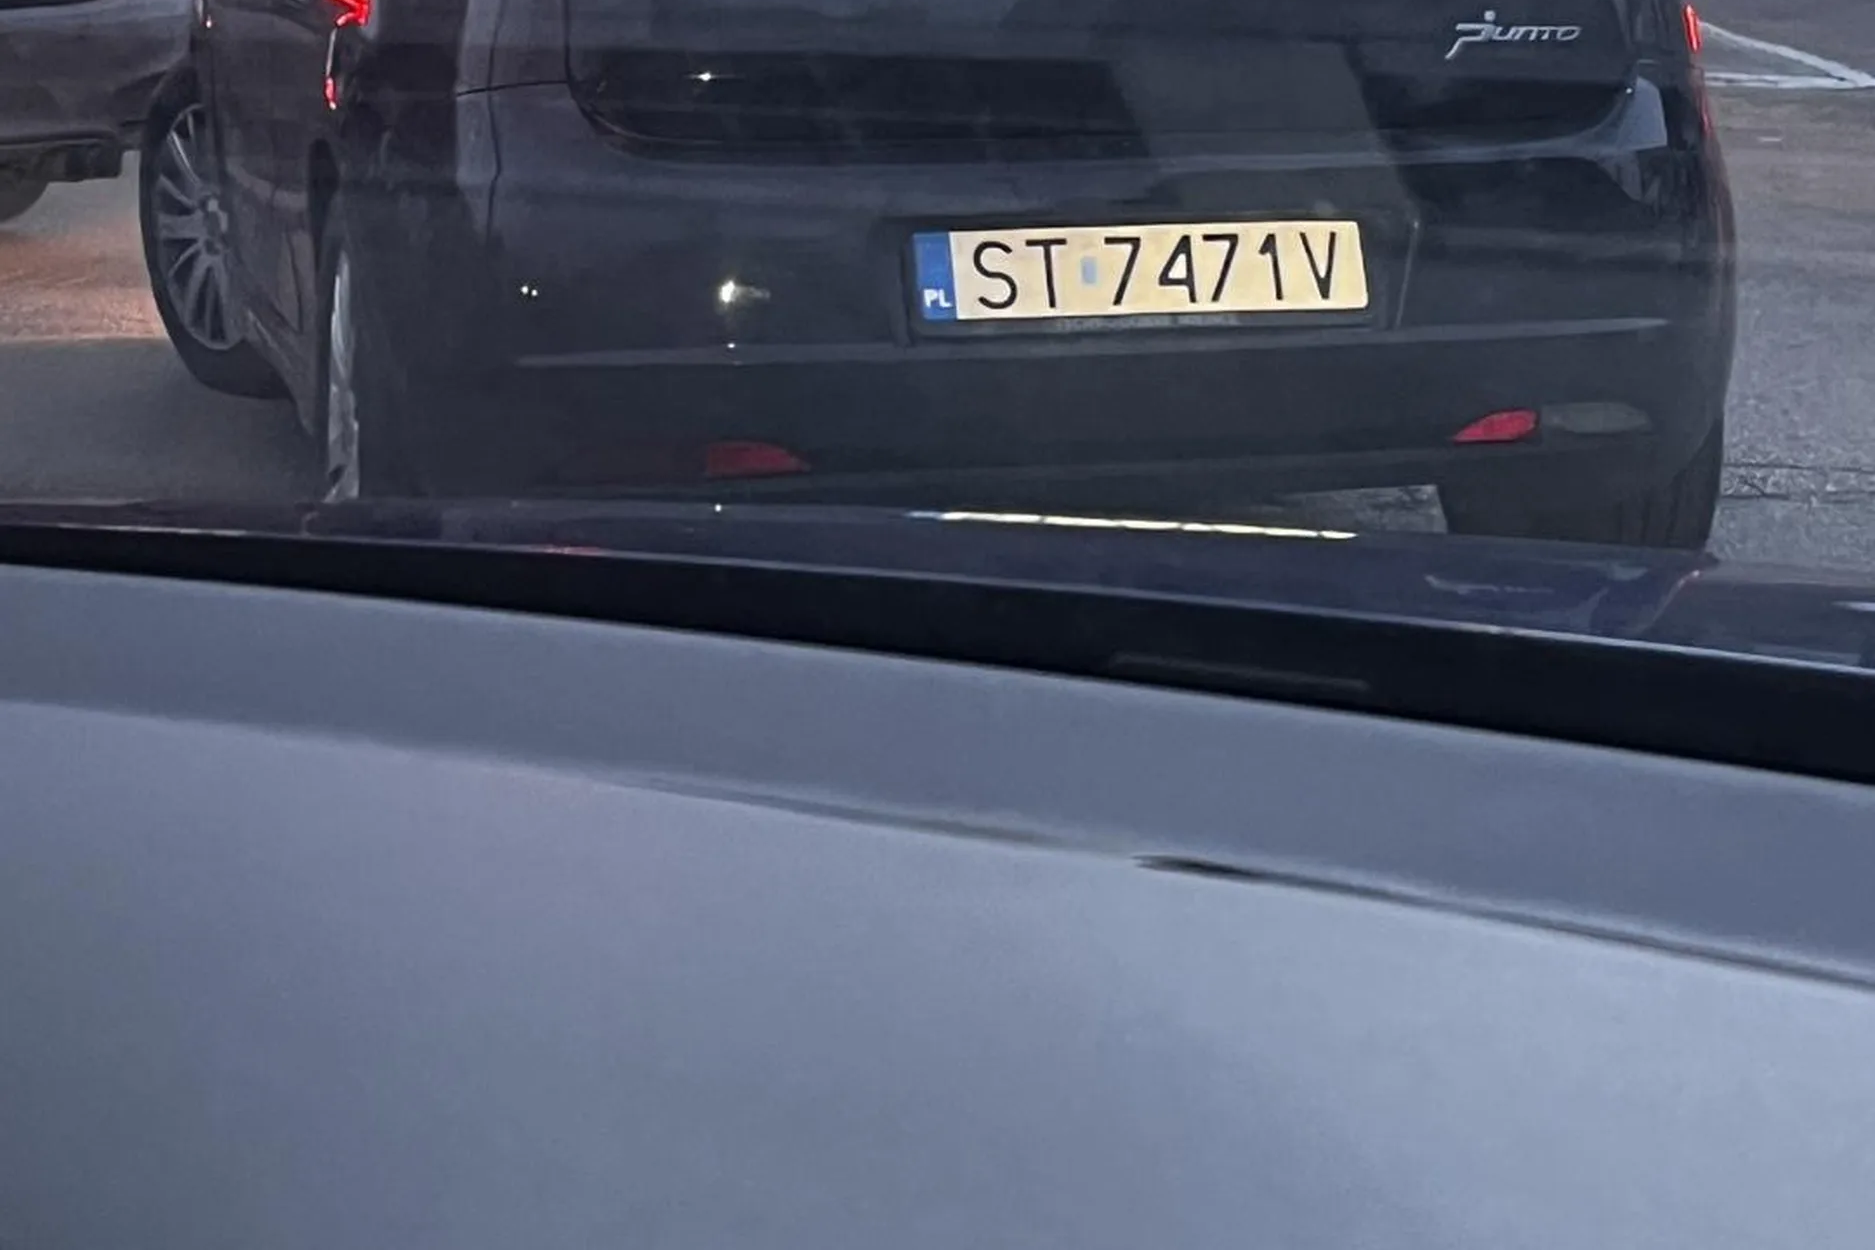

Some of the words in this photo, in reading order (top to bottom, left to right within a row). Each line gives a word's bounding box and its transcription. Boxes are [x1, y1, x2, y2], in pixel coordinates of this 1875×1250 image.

[973, 239, 1067, 309] ST
[1104, 230, 1337, 306] 7471V
[923, 288, 952, 308] PL
